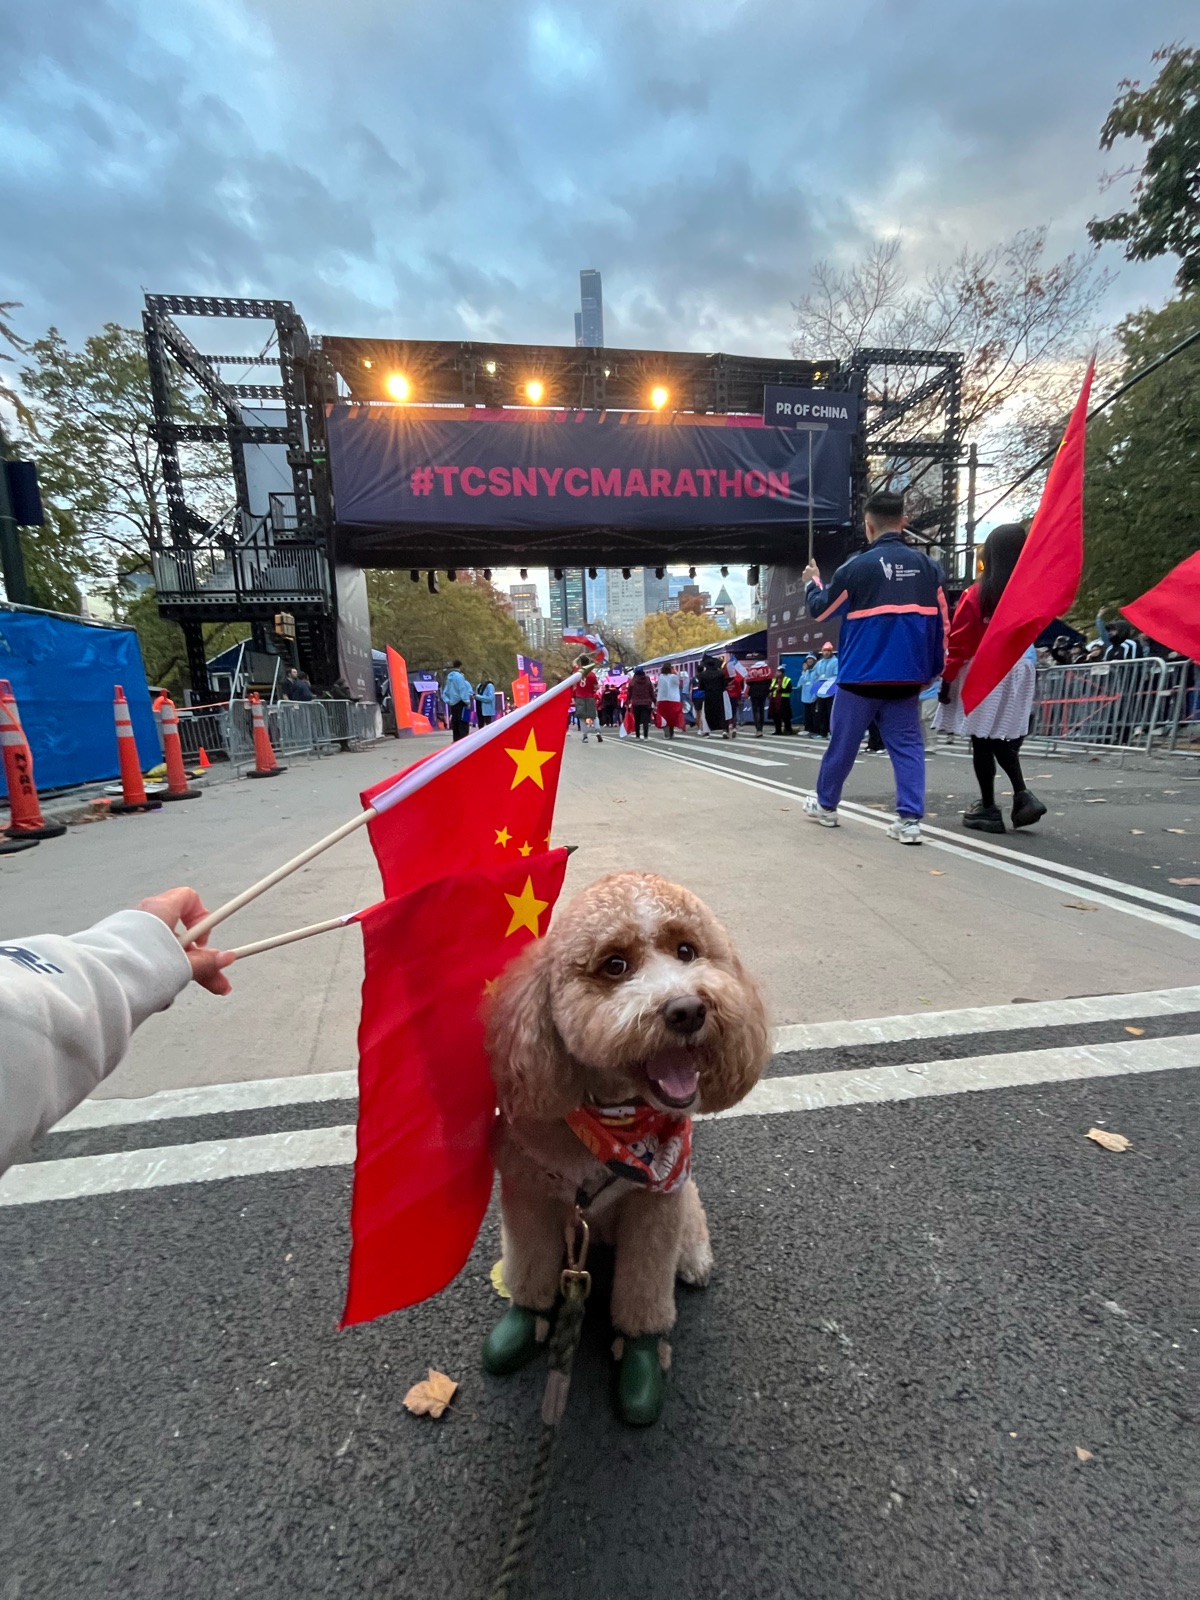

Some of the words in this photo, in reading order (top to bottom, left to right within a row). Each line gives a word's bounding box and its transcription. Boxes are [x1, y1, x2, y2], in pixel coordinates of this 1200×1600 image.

[776, 402, 792, 415] PR
[794, 403, 810, 416] OF
[812, 405, 848, 420] CHINA
[410, 466, 791, 498] #TCSNYCMARATHON
